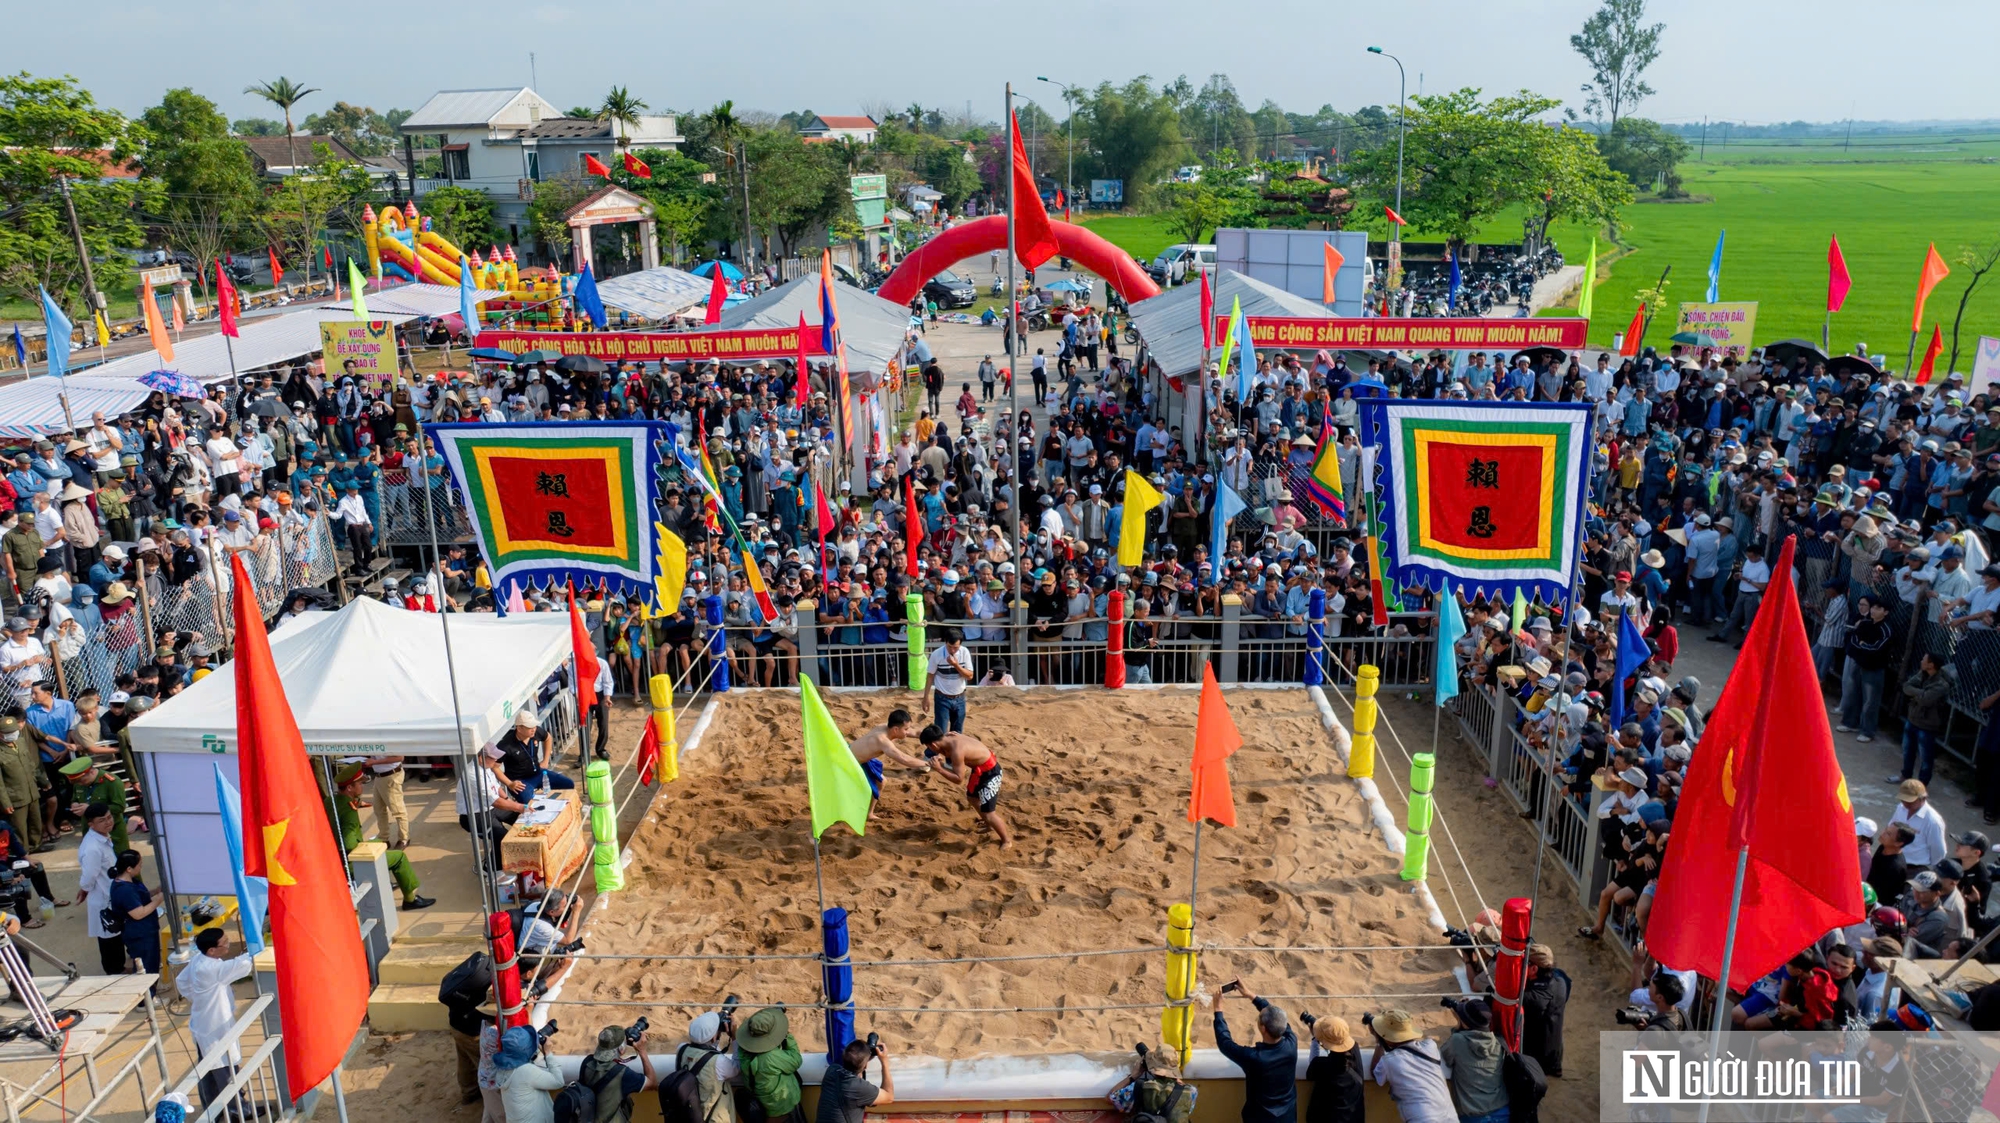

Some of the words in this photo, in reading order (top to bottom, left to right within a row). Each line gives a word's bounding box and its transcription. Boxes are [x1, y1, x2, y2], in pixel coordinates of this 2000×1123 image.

[1251, 321, 1275, 341] ẢNG
[1279, 323, 1314, 343] CỘNG
[1317, 322, 1343, 342] SẢN
[1347, 324, 1373, 345] VIỆT
[1376, 326, 1406, 342] NAM
[1409, 327, 1451, 343] QUANG
[1454, 327, 1484, 343] VINH
[1487, 325, 1526, 342] MUÔN
[1528, 325, 1563, 342] NĂM!
[564, 337, 587, 354] HÒA
[589, 337, 605, 354] XÃ
[606, 337, 625, 357] HỘI
[628, 335, 650, 354] CHỦ
[652, 335, 686, 354] NGHĨA
[689, 335, 713, 355] VIỆT
[716, 337, 742, 353] NAM
[745, 334, 779, 352] MUÔN
[375, 744, 386, 752] PQ
